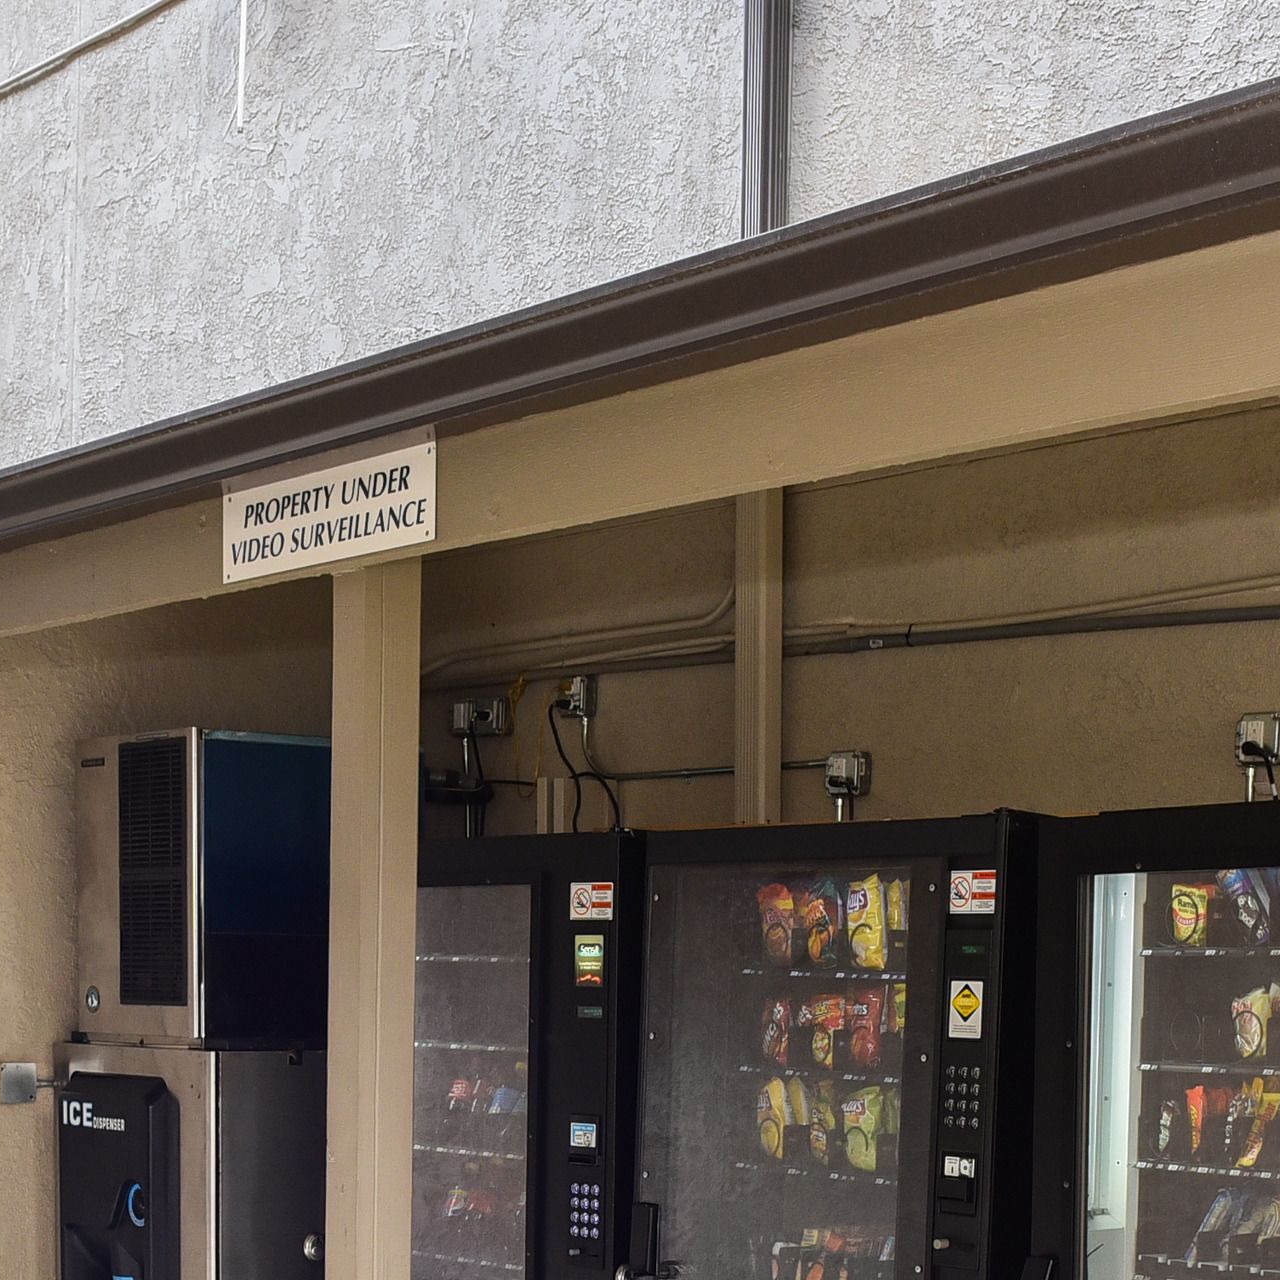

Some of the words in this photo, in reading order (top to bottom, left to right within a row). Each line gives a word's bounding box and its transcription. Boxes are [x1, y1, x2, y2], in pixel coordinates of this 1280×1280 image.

[244, 484, 335, 528] PROPERTY
[341, 465, 410, 505] UNDER
[231, 532, 284, 566] VIDEO
[290, 498, 427, 553] SURVEILLANCE
[63, 1100, 93, 1128] ICE
[93, 1117, 125, 1132] DISPENSER
